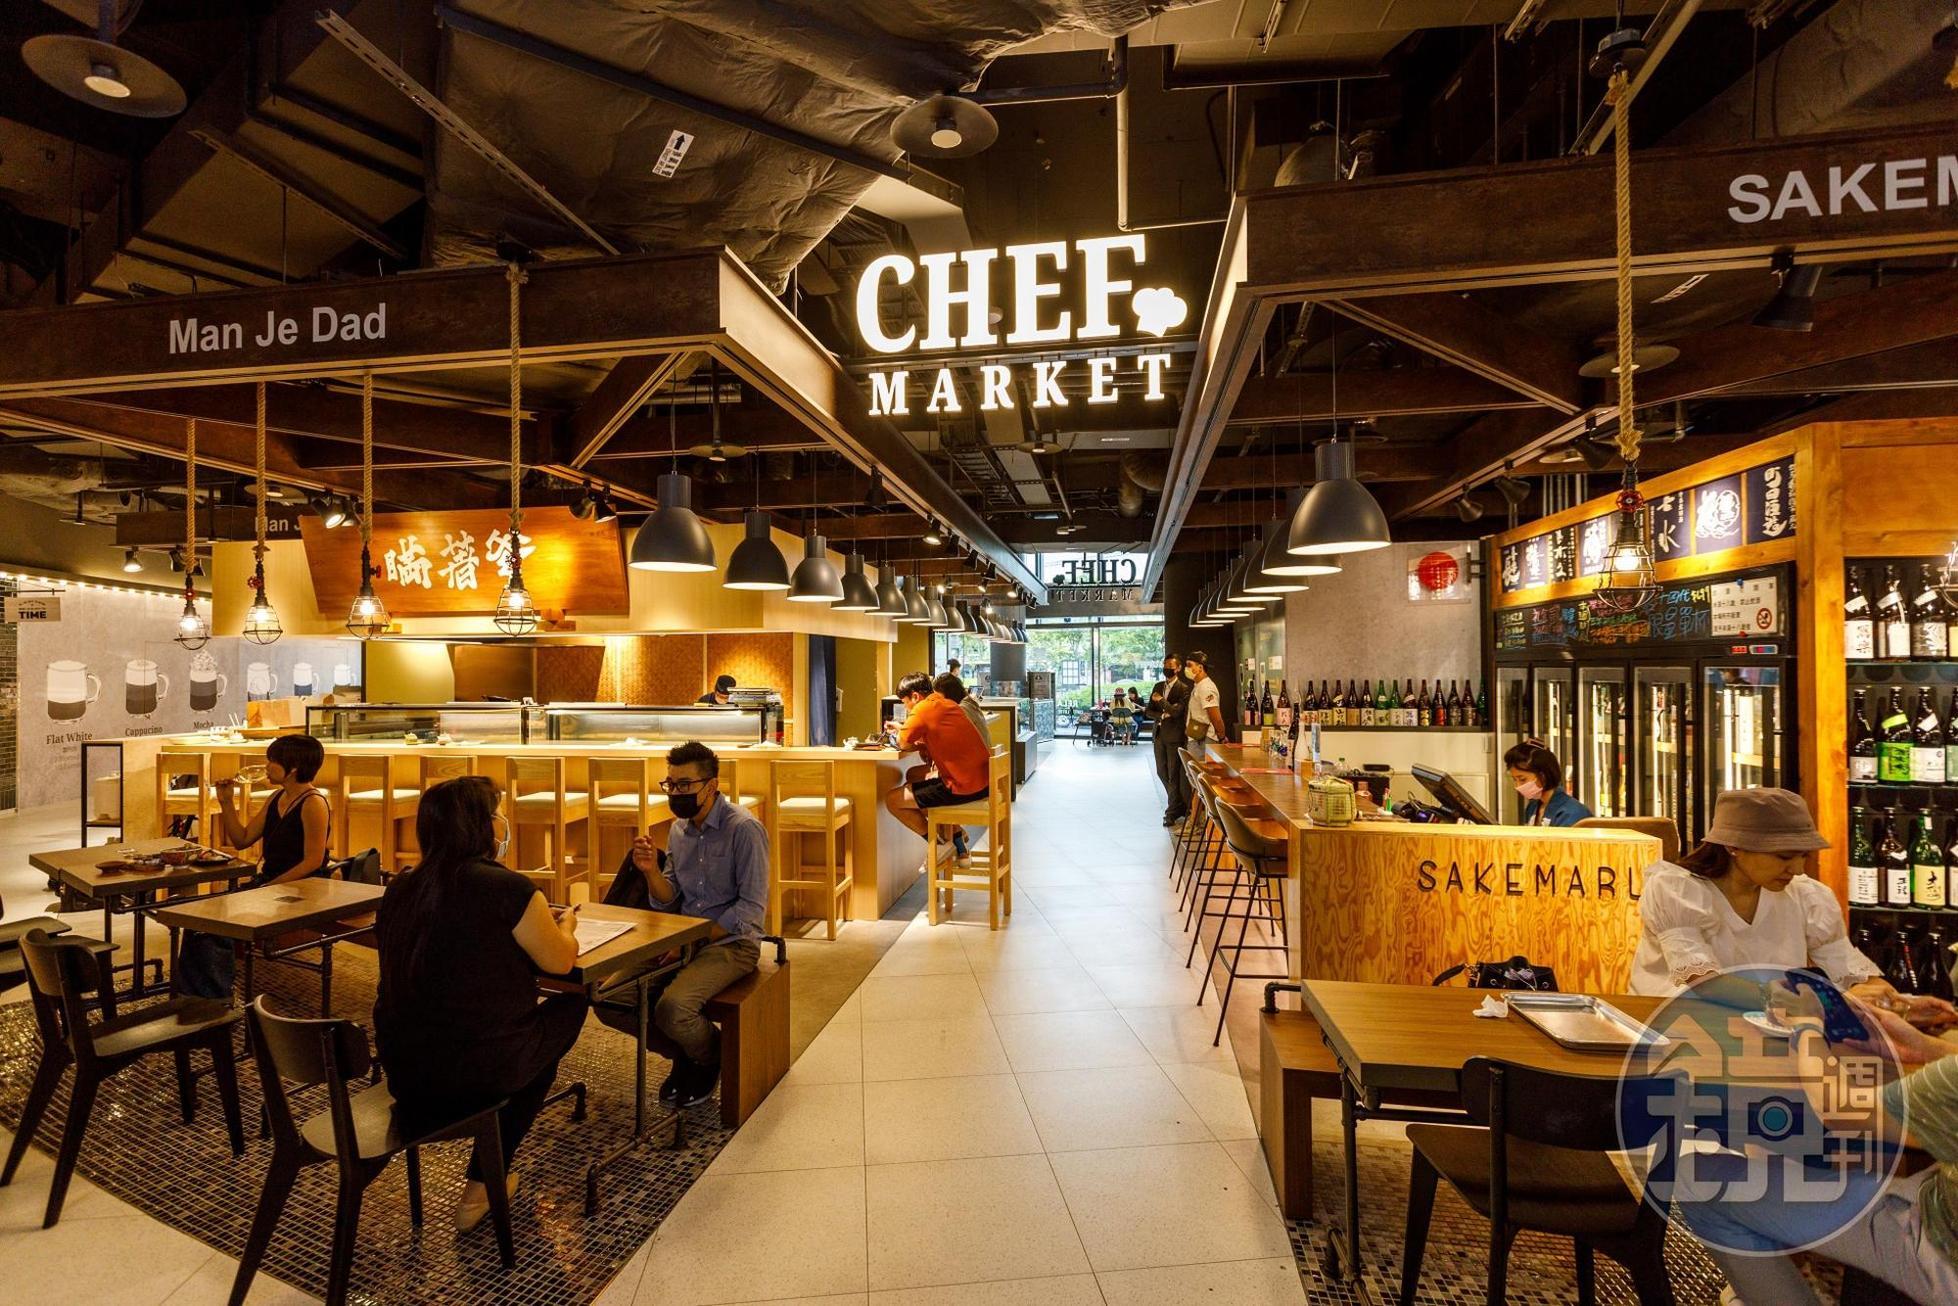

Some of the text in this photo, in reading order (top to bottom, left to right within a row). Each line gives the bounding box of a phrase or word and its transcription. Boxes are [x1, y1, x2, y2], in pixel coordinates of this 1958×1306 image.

[856, 233, 1146, 354] CHEF
[169, 302, 387, 354] Man Je Dad
[868, 353, 1171, 416] MARKET
[18, 610, 47, 619] TIME
[46, 731, 93, 745] Flat White
